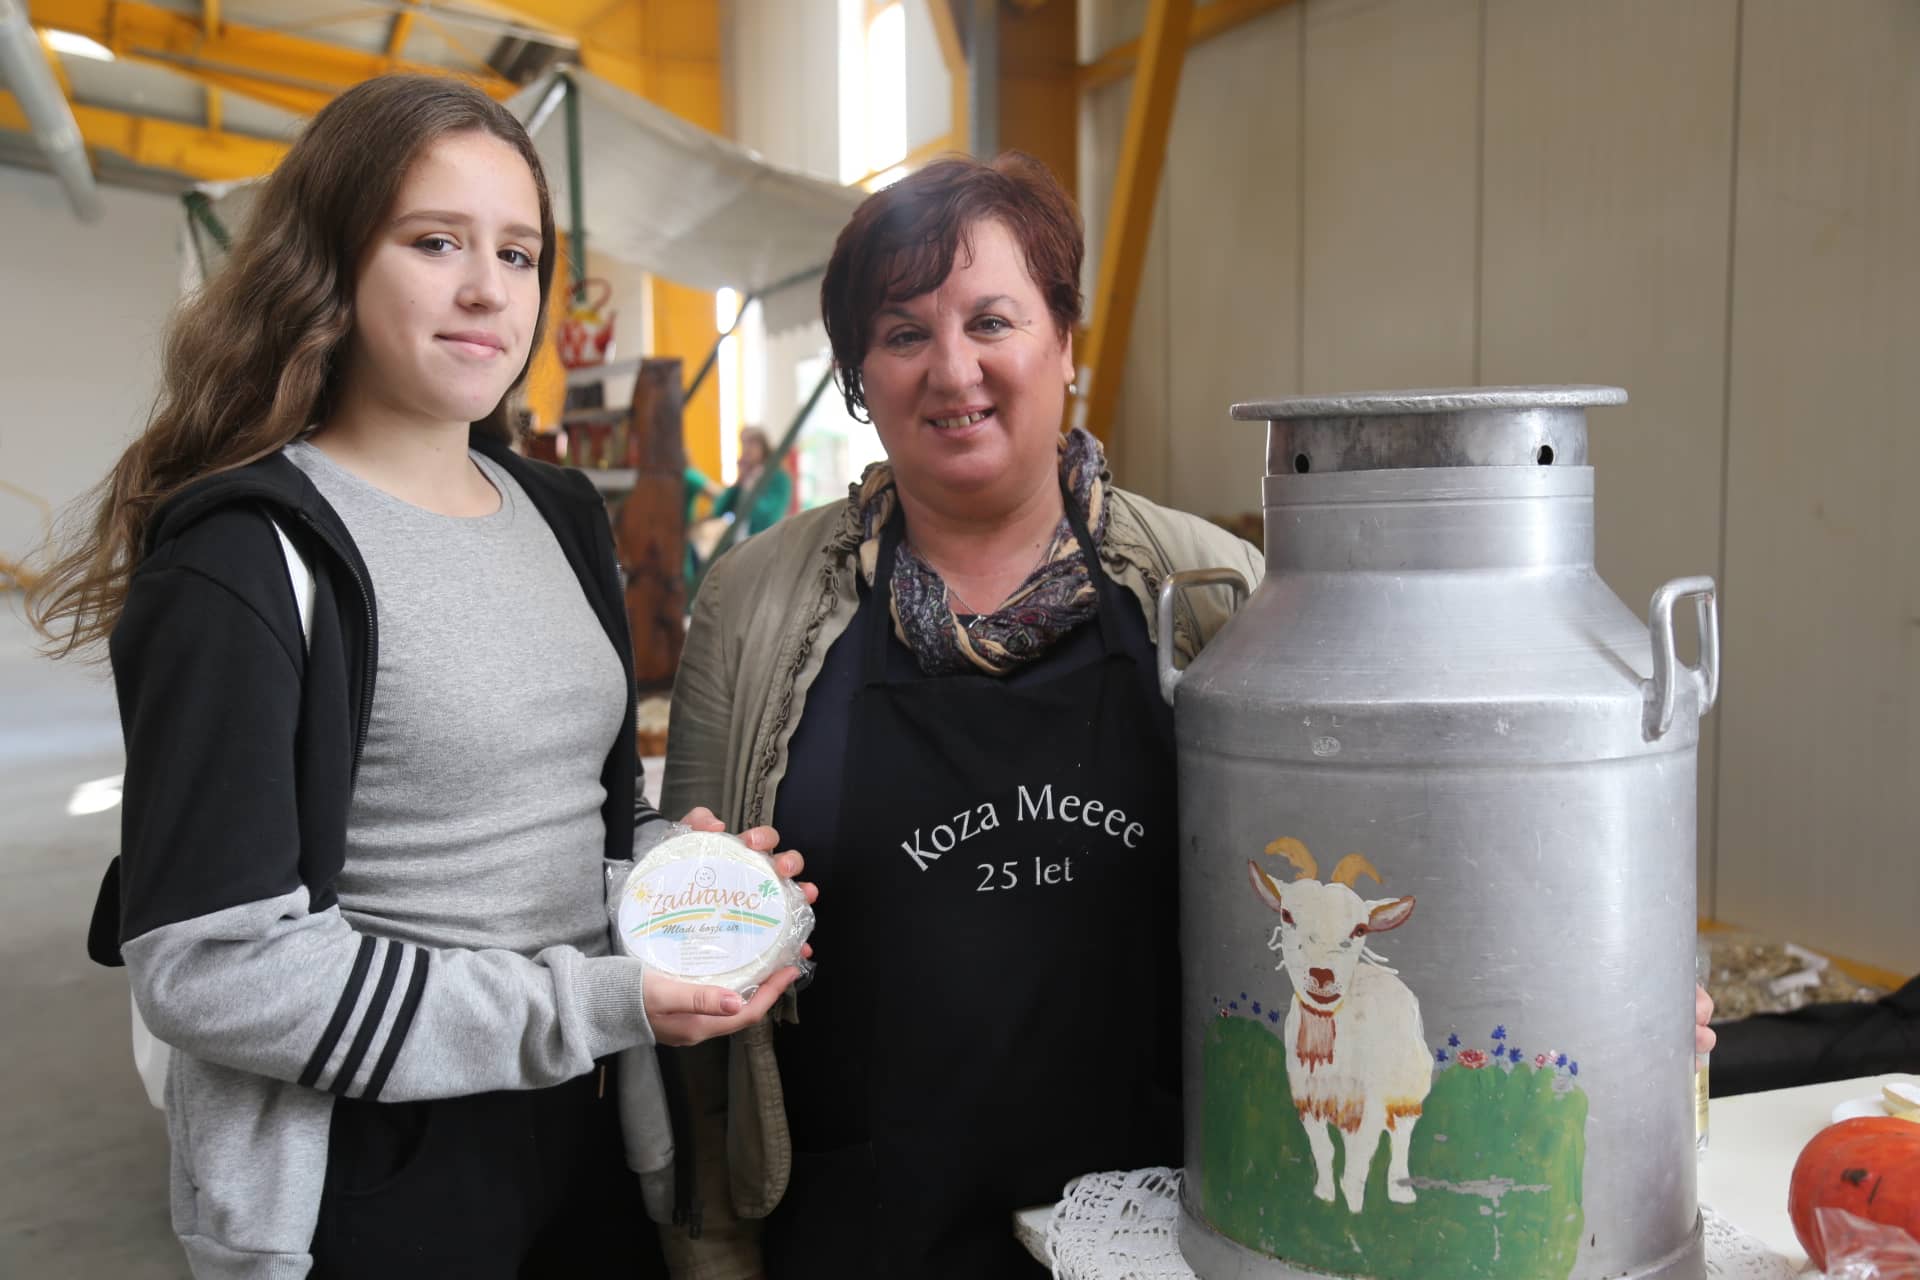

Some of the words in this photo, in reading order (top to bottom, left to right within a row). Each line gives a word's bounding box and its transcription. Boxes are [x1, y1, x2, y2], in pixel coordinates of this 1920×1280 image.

[900, 802, 1000, 872] Koza
[1017, 783, 1145, 848] Meeee
[976, 860, 1018, 892] 25
[1035, 856, 1074, 886] let
[662, 924, 695, 935] Mladi
